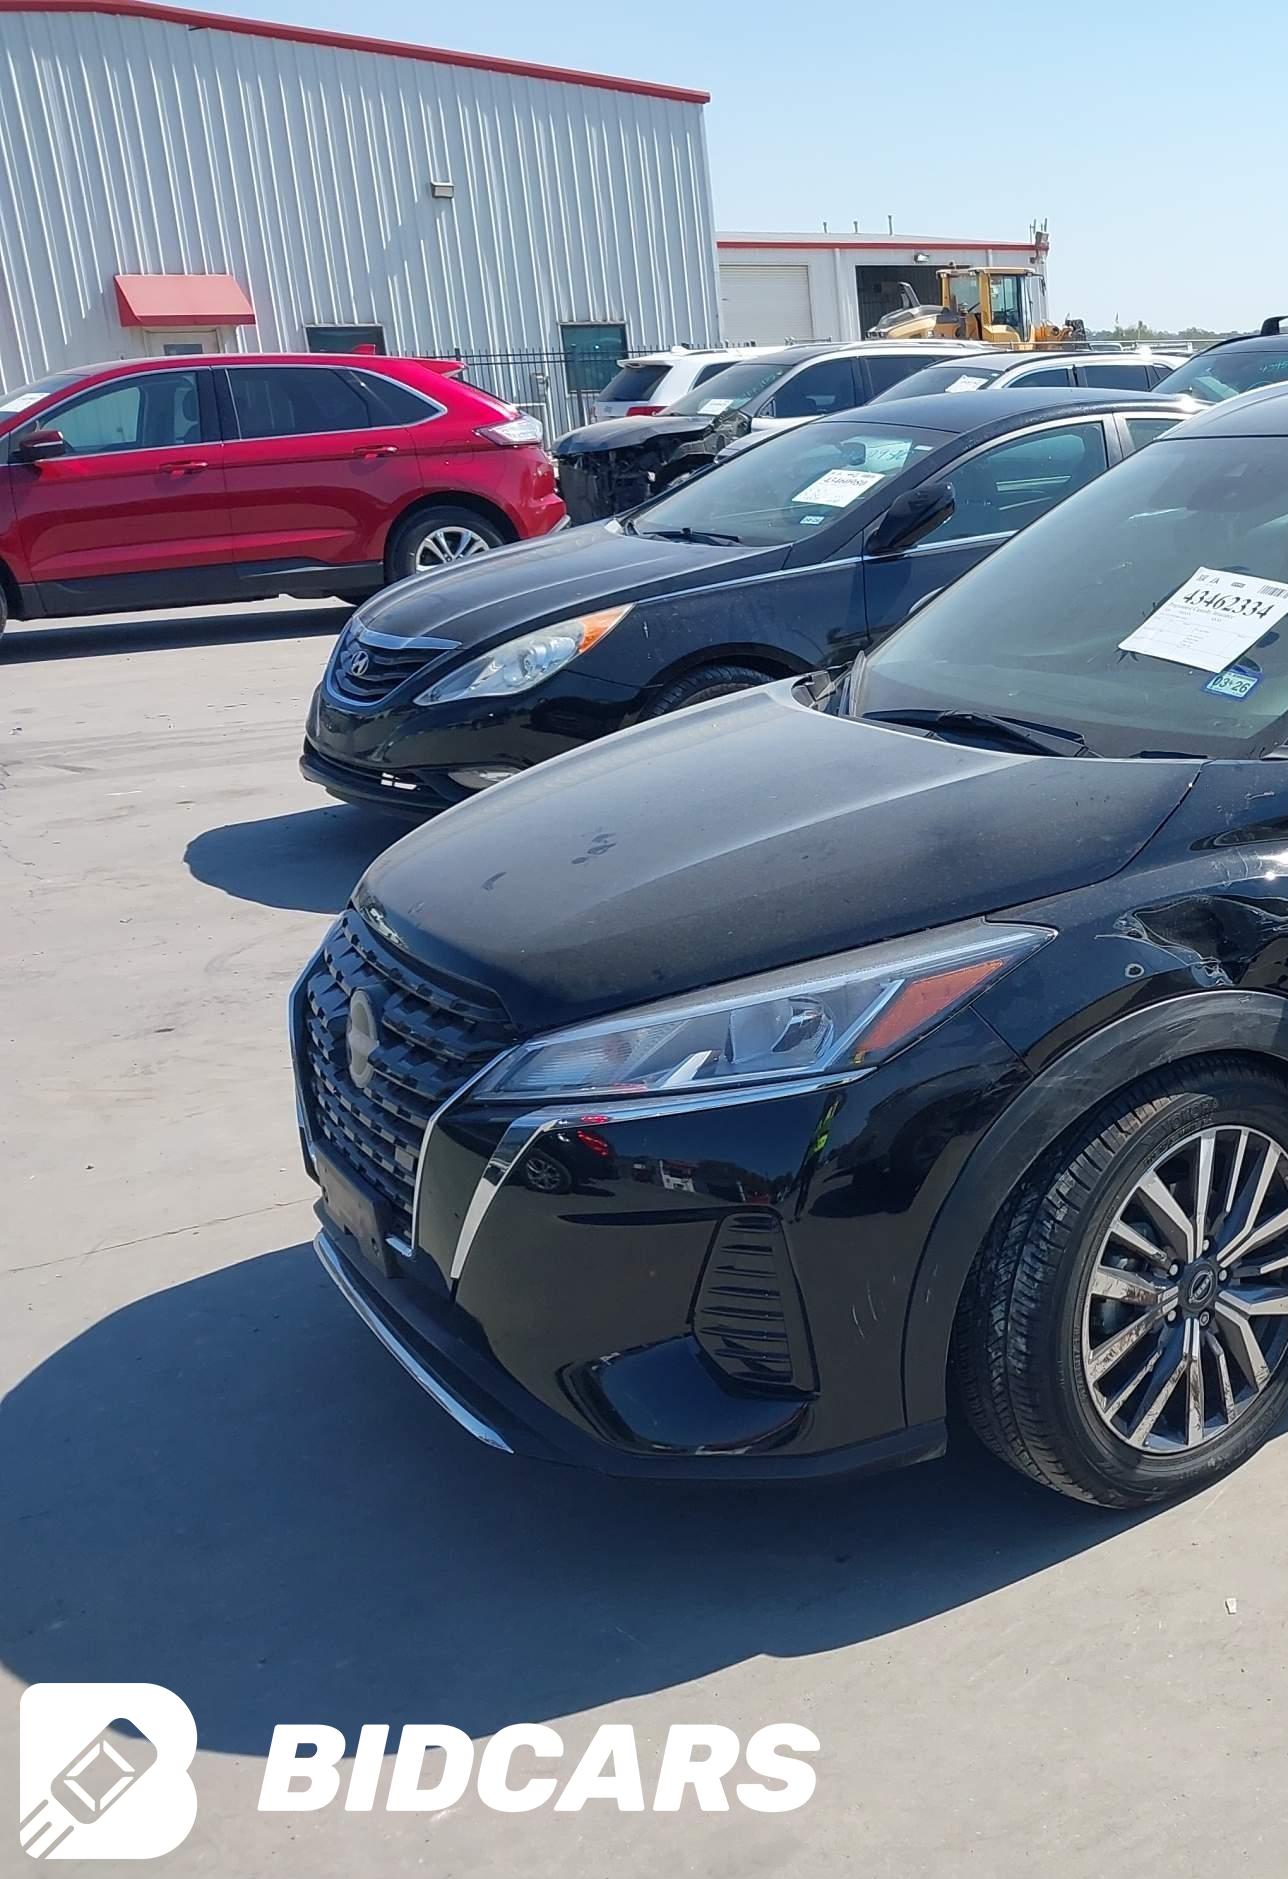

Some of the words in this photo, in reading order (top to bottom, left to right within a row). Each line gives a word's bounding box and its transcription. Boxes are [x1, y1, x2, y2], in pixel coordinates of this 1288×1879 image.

[1183, 589, 1275, 619] 43462334
[1212, 676, 1231, 688] 03
[1231, 680, 1251, 693] 26
